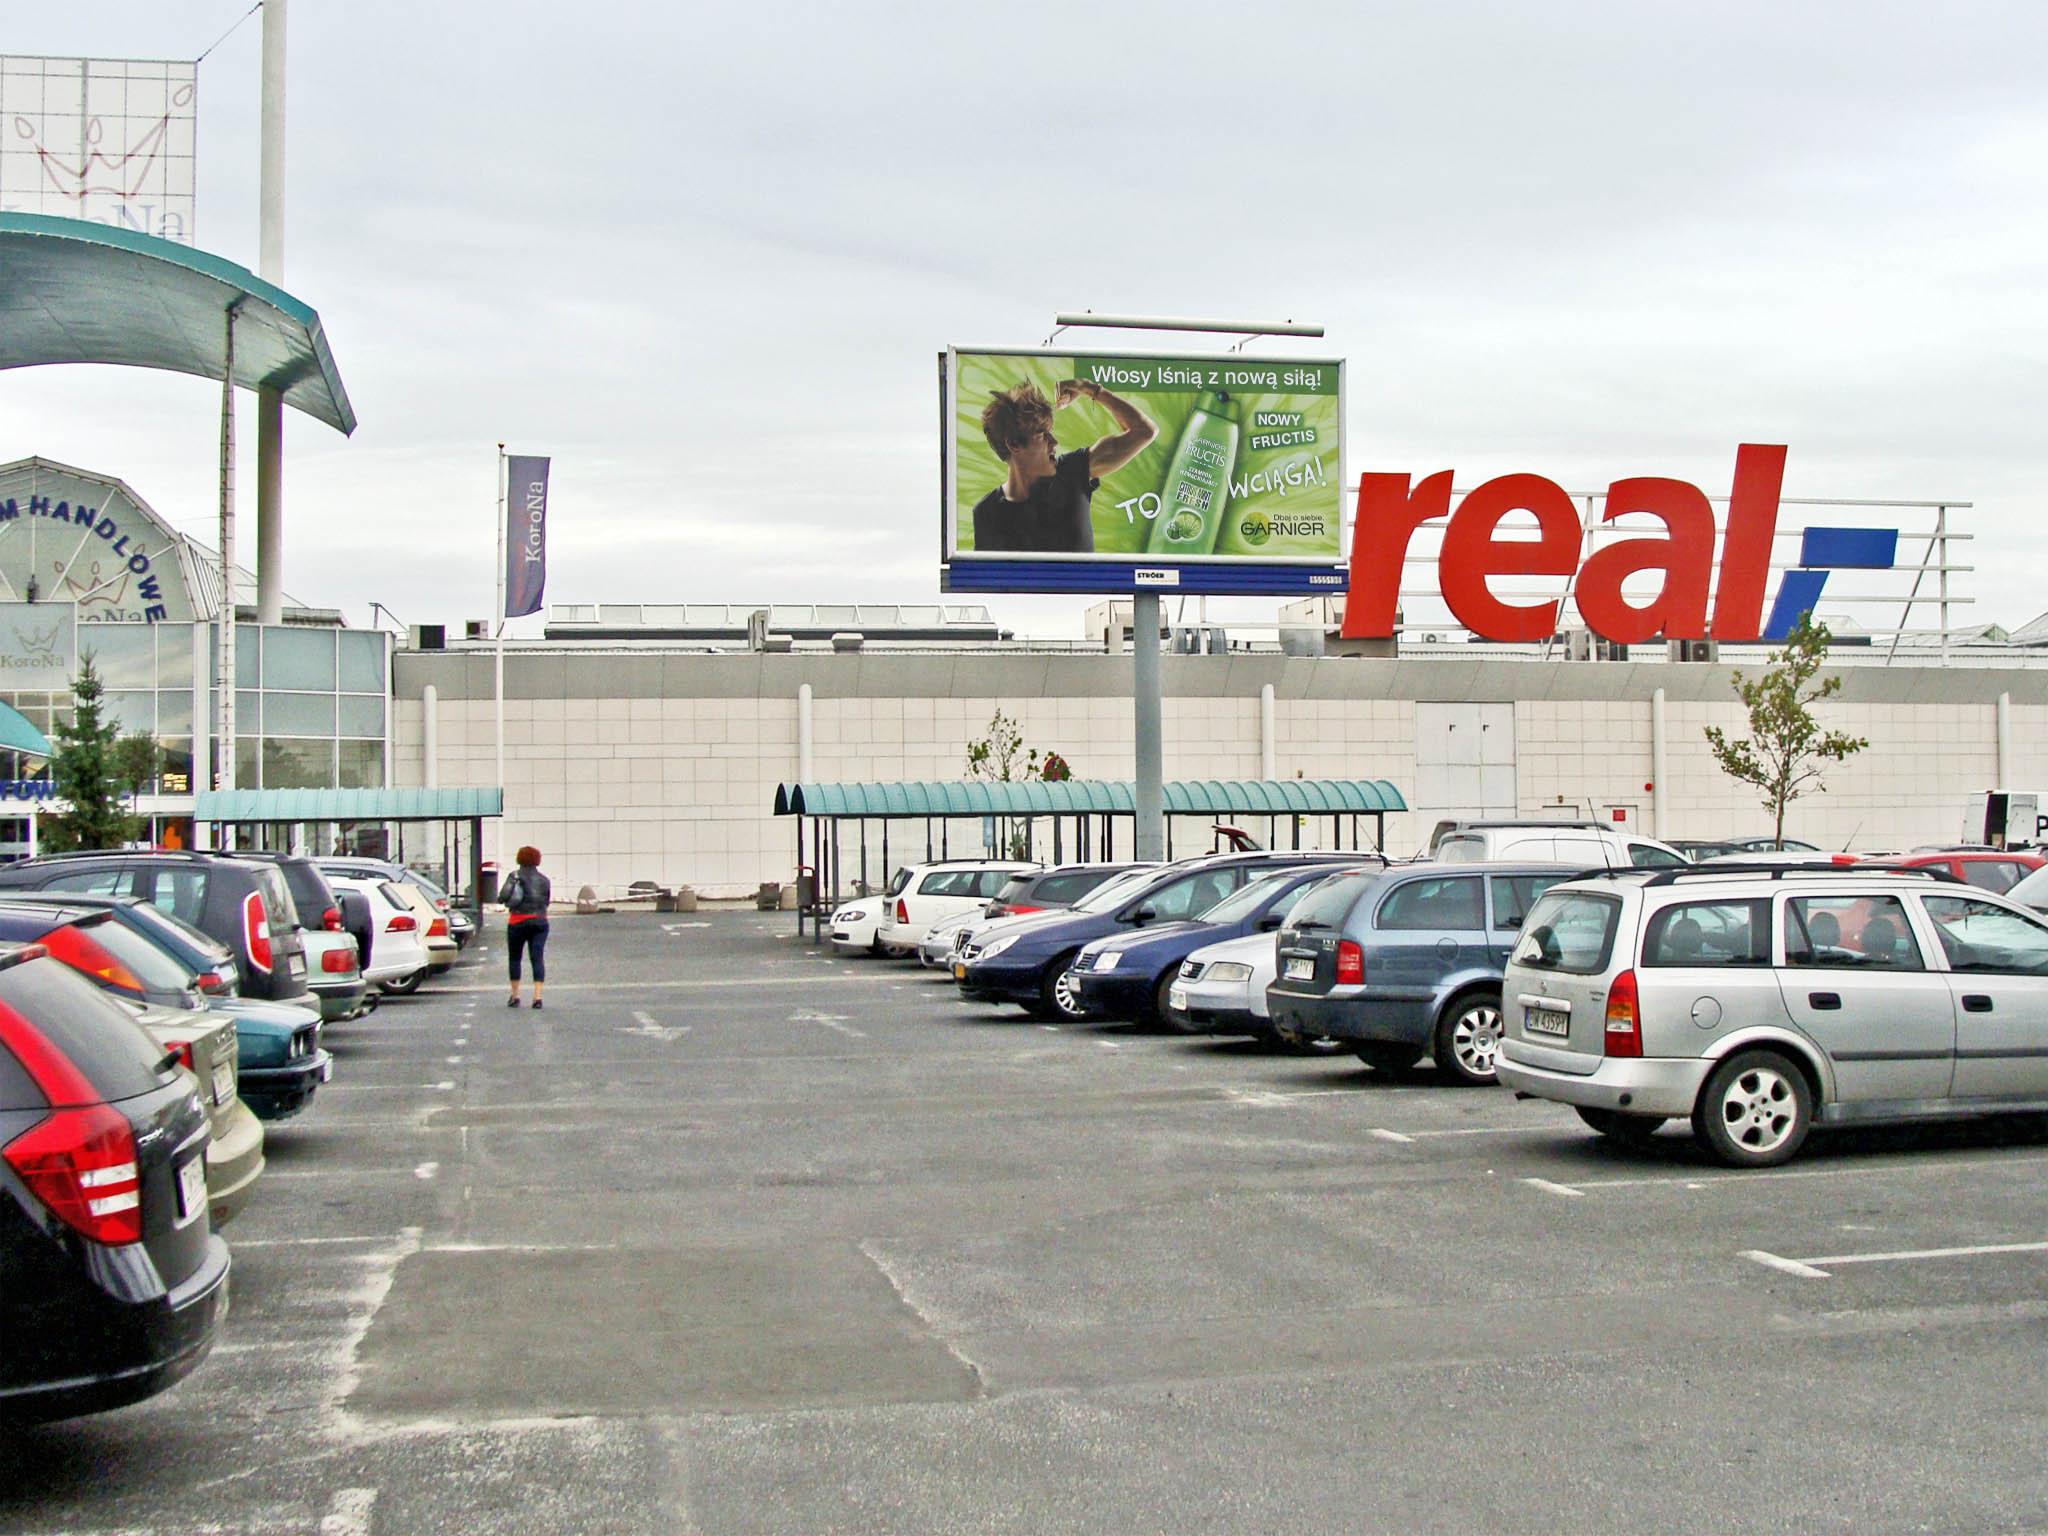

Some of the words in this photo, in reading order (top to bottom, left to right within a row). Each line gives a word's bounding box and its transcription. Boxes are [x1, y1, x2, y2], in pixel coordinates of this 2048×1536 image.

[1092, 365, 1151, 388] Włosy
[1157, 366, 1203, 389] lśnią
[1208, 370, 1219, 385] z
[1225, 369, 1278, 390] nową
[1283, 369, 1322, 390] siłą!
[1258, 414, 1300, 426] NOWY
[1252, 430, 1315, 448] FRUCTIS
[1115, 492, 1161, 524] TO
[1227, 455, 1327, 499] WCIĄGA!
[524, 481, 544, 562] KoroNa
[1241, 522, 1325, 535] GARNIER
[29, 495, 167, 625] HANDLOWE
[0, 653, 65, 669] KoroNa
